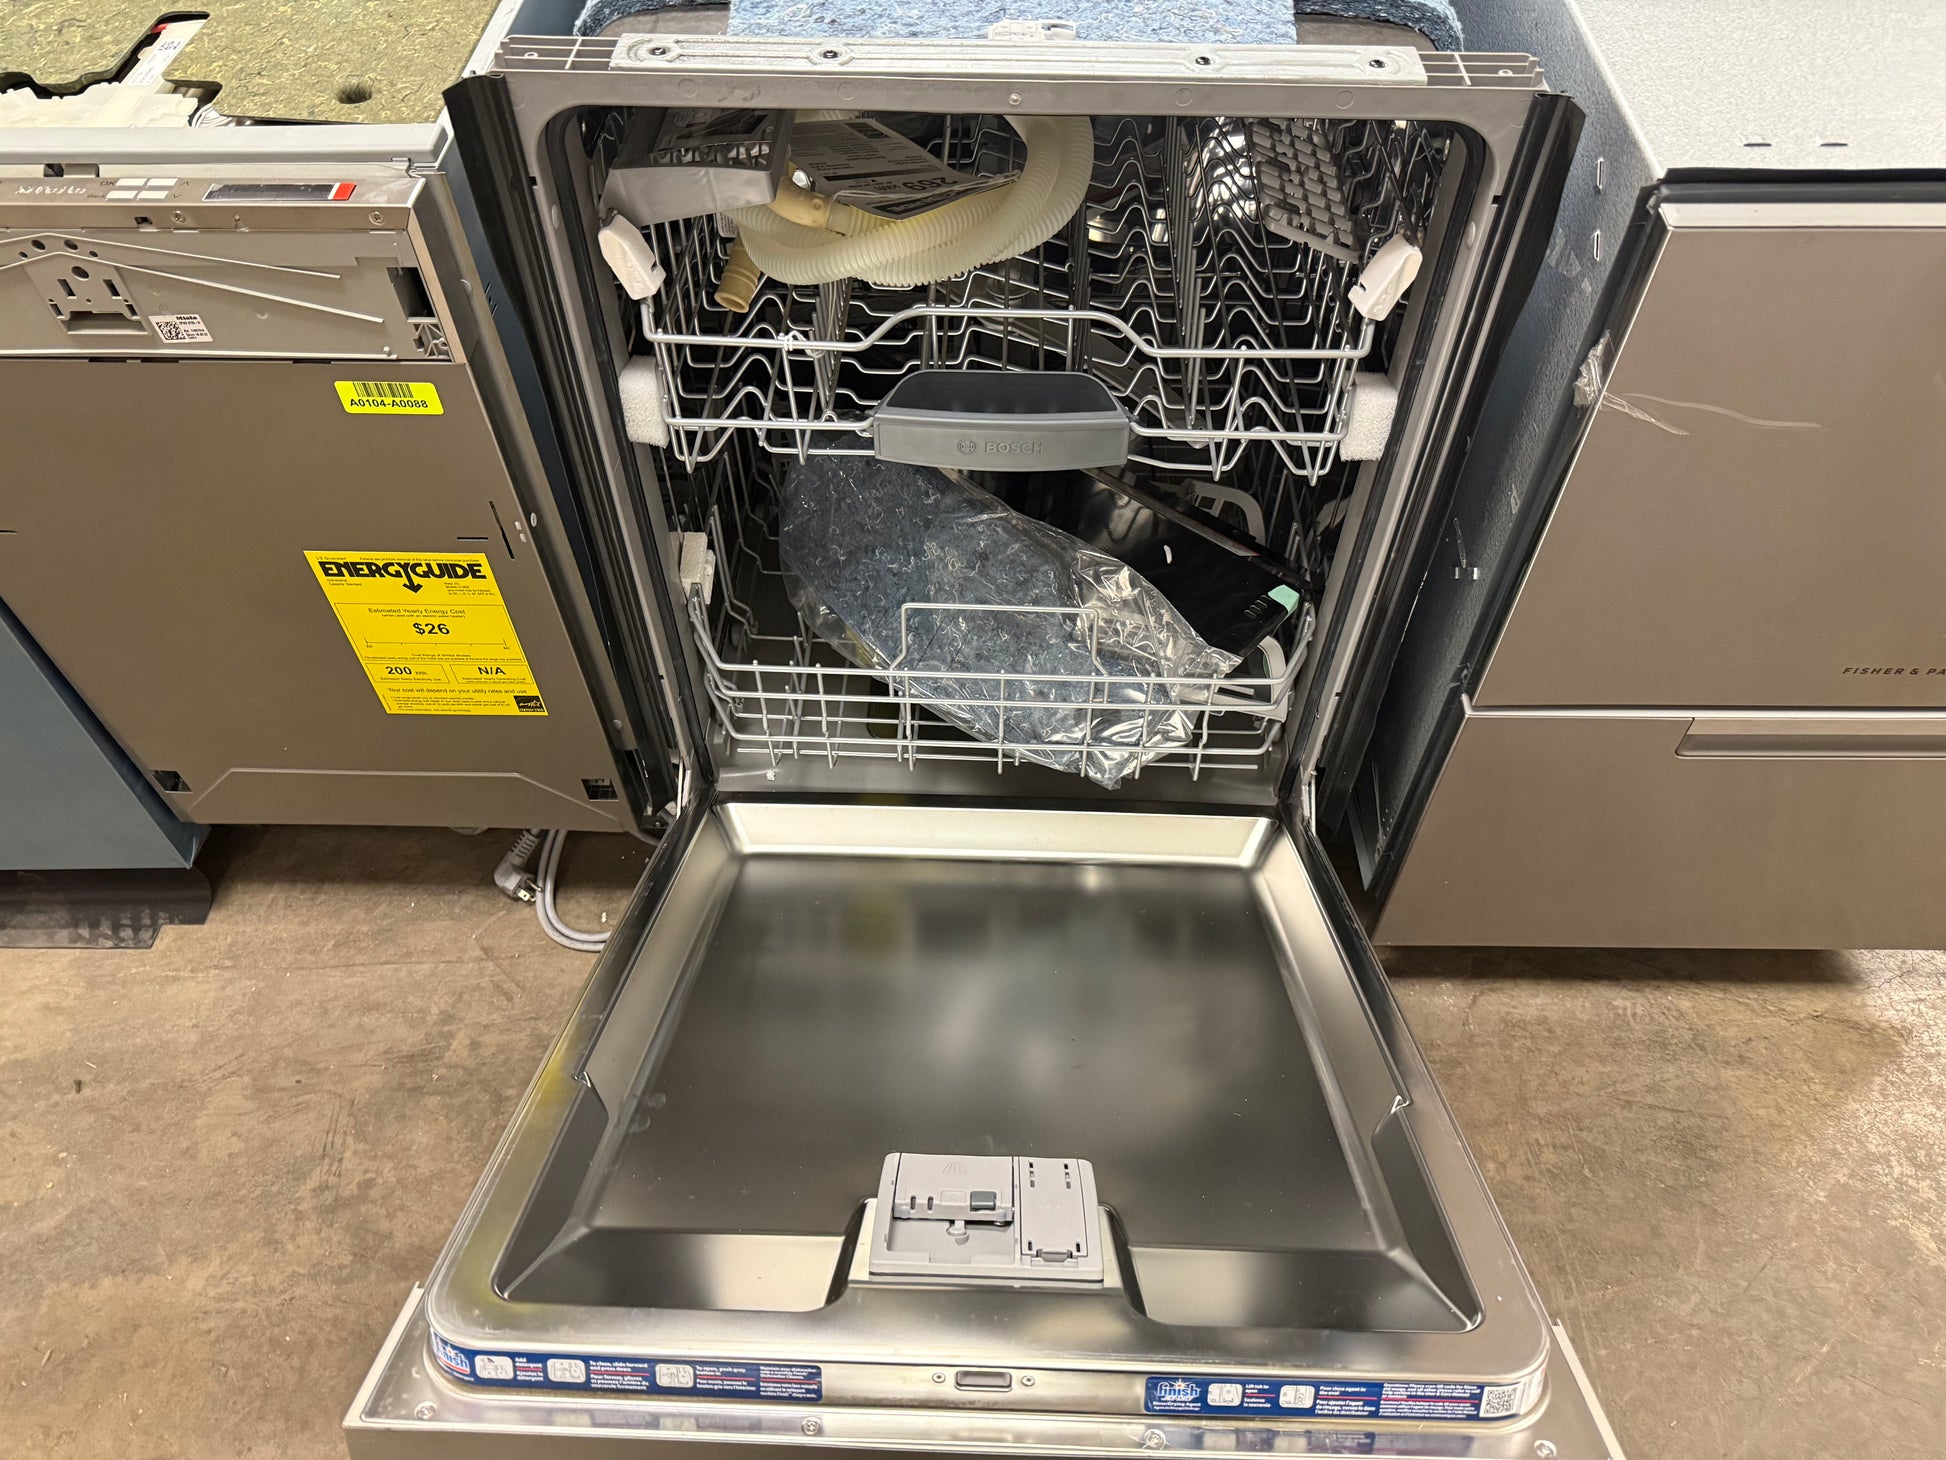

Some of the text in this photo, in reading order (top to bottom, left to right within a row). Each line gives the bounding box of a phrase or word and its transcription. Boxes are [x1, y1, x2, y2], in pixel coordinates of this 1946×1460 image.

[350, 398, 428, 408] A0104-A0088
[984, 441, 1044, 454] BOSCH
[318, 561, 487, 579] ENERGYGUIDE
[413, 623, 450, 635] $26
[386, 666, 412, 675] 200
[478, 667, 506, 675] N/A
